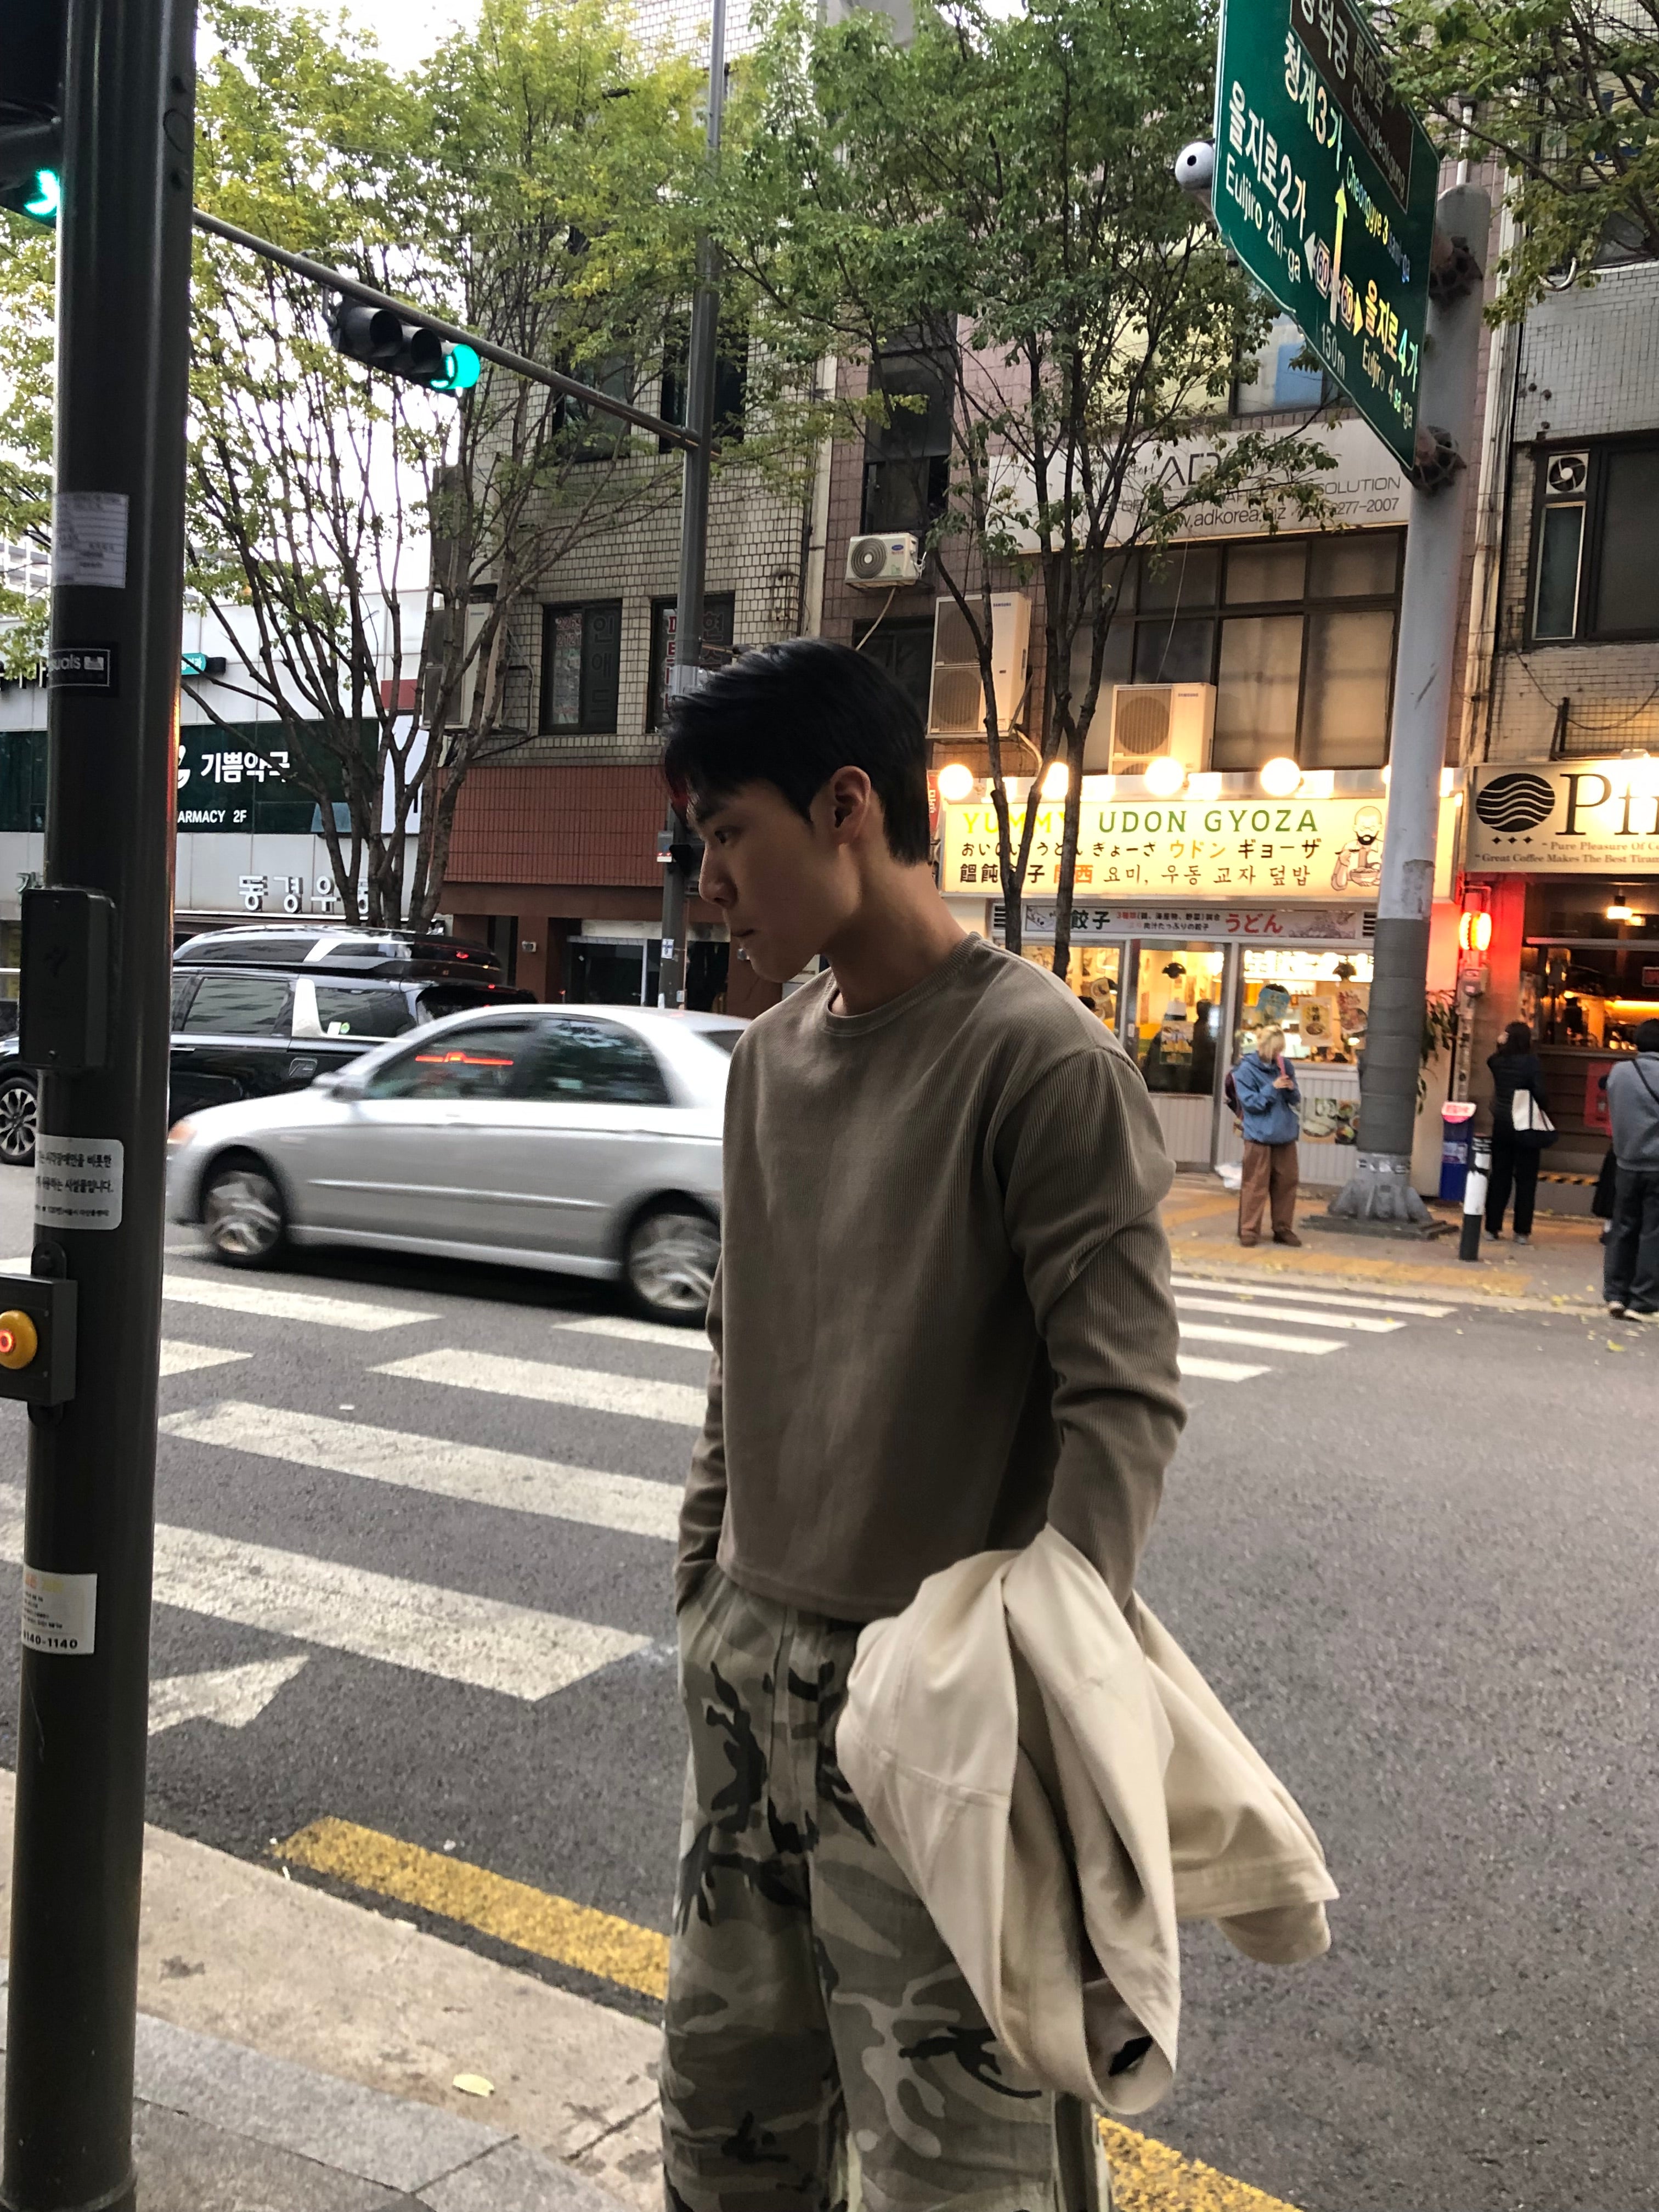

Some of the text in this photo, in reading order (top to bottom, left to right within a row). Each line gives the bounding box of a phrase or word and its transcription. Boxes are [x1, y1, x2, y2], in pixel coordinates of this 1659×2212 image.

[1284, 31, 1344, 172] 청계3가
[1229, 80, 1306, 241] 을지로2가
[1226, 153, 1262, 230] Euljiro
[1346, 155, 1382, 238] Cheonggye
[1318, 250, 1328, 287] 60
[1342, 285, 1352, 318] 60
[1321, 322, 1346, 380] 150m
[1364, 279, 1419, 393] 을지로4가
[1362, 338, 1385, 391] Euljiro
[200, 751, 291, 783] 기쁨약국
[177, 809, 247, 824] ARMACY 2F
[1099, 810, 1187, 833] UDON
[1204, 809, 1318, 833] GYOZA
[1170, 839, 1226, 859] ウドン
[1238, 838, 1322, 859] ギョーザ
[1513, 853, 1544, 862] Coffee
[1547, 854, 1580, 863] Makes
[1583, 854, 1601, 863] The
[1605, 854, 1626, 863] Best
[1580, 842, 1628, 851] Pleasure
[960, 863, 1045, 884] 饂飩子
[1161, 865, 1201, 885] 우동
[1213, 865, 1256, 886] 교자
[1224, 913, 1284, 934] うどん
